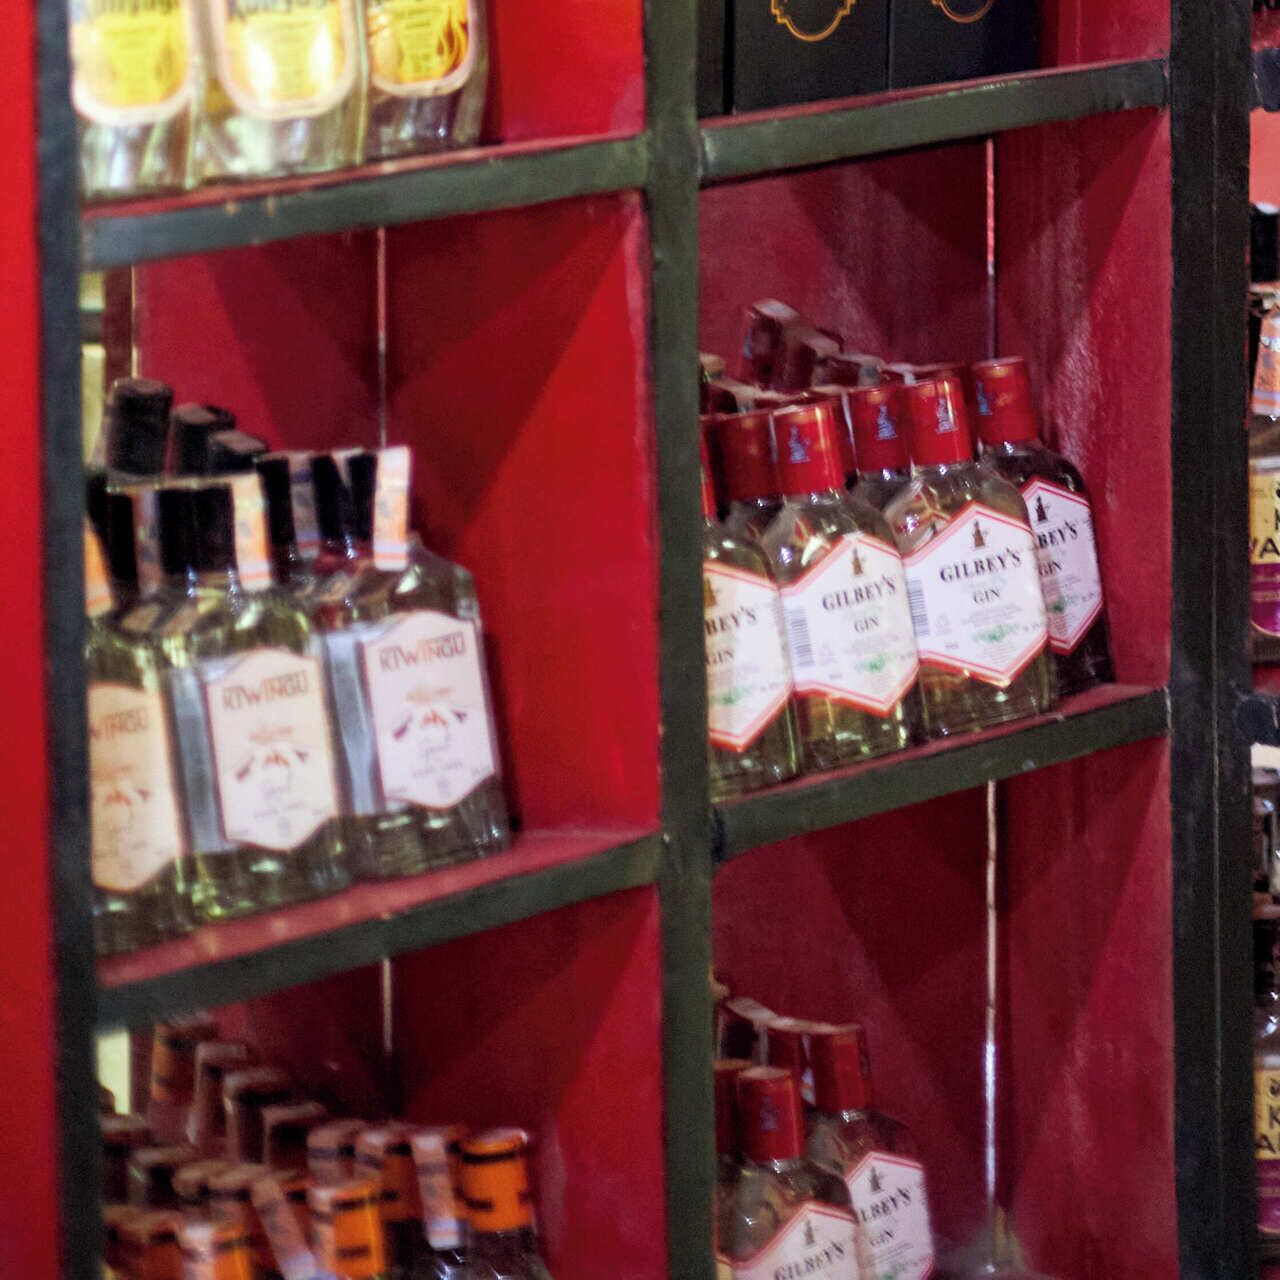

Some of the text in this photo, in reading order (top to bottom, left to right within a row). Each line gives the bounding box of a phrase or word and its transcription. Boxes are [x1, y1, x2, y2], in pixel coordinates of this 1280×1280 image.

[1037, 519, 1079, 549] BEY'S
[940, 547, 1022, 584] GILBEY'S
[821, 575, 897, 611] GILBEY'S
[973, 588, 1001, 605] GIN
[704, 605, 757, 636] BEY'S
[853, 616, 881, 633] GIN
